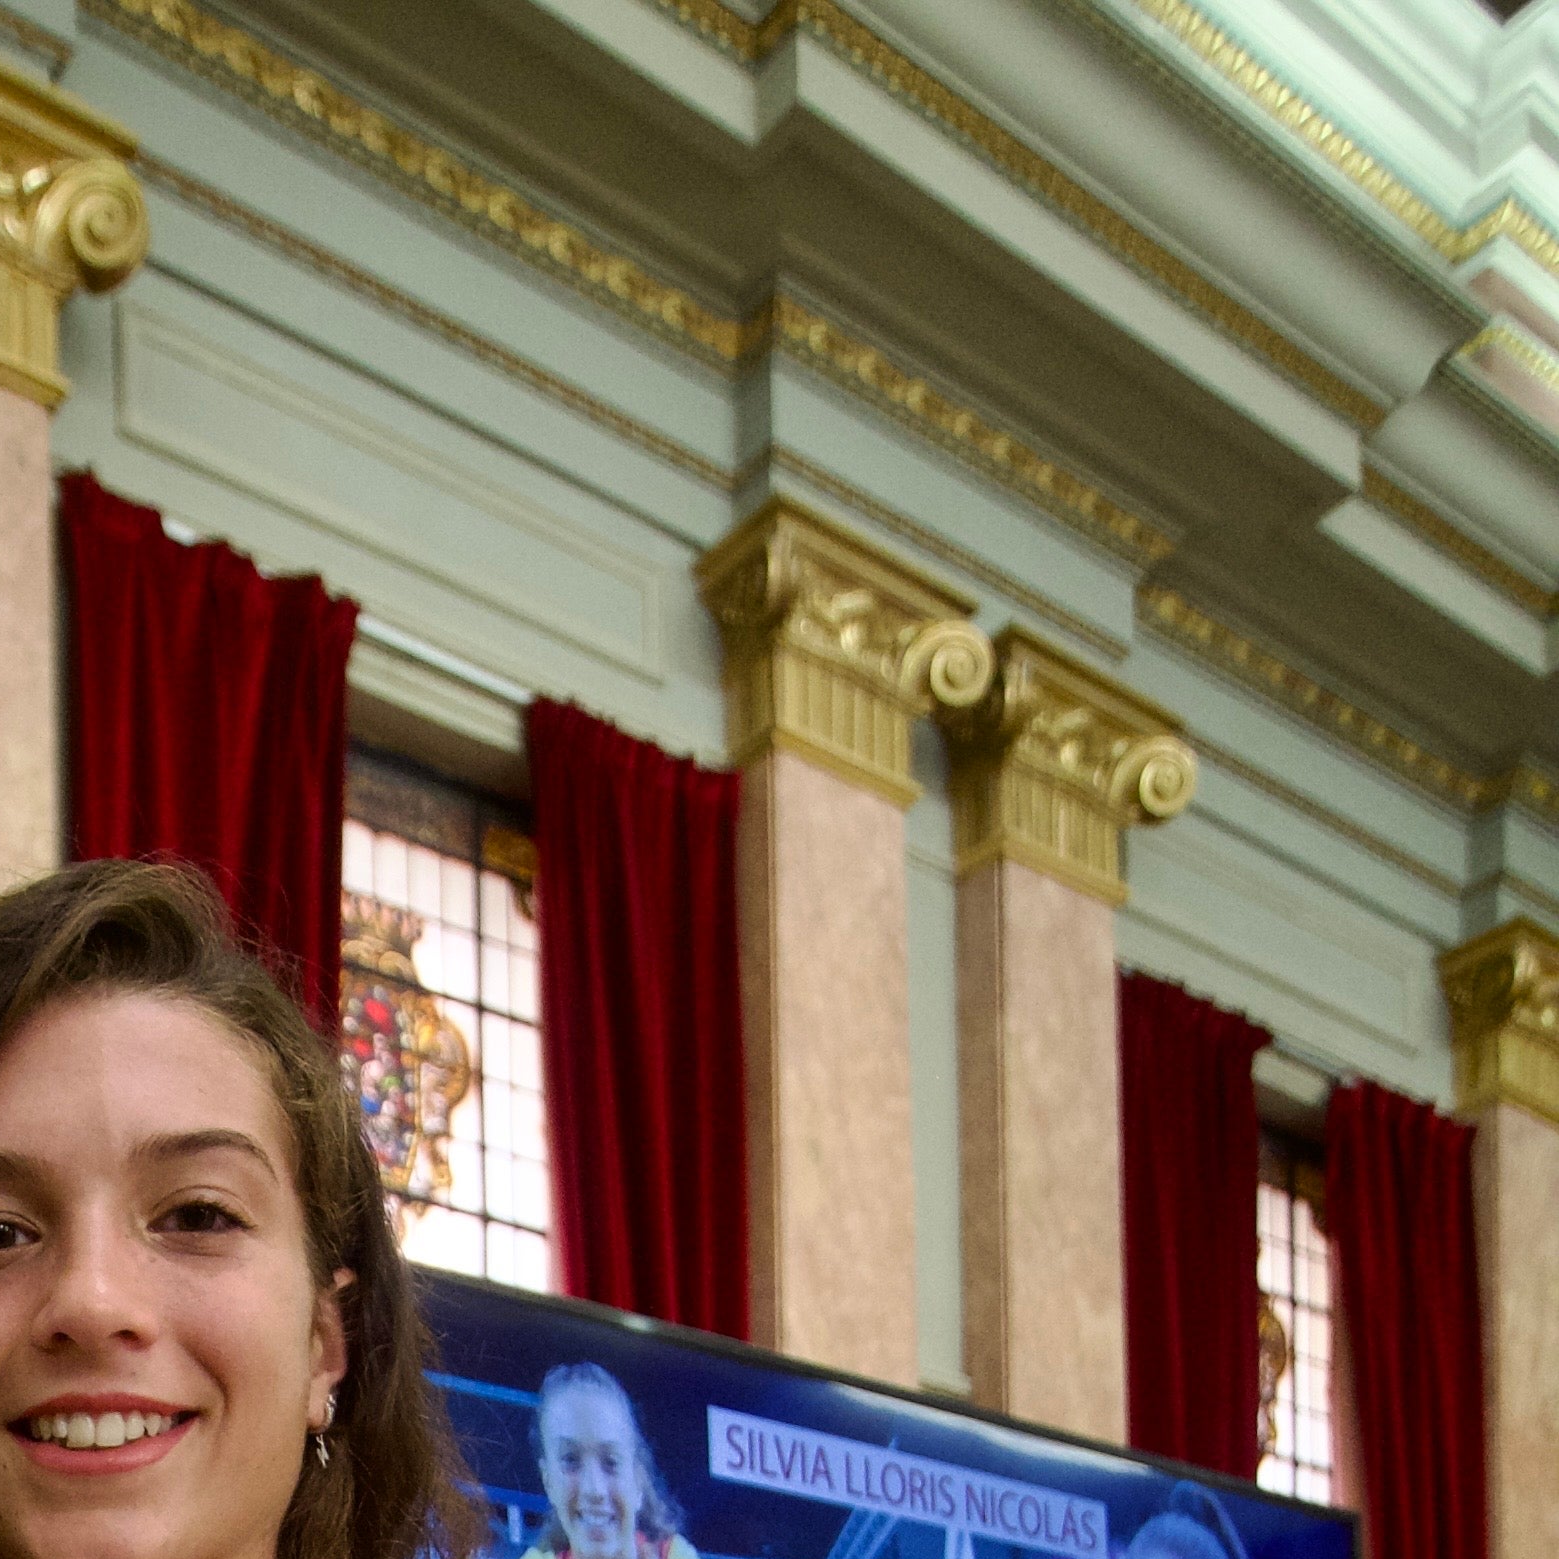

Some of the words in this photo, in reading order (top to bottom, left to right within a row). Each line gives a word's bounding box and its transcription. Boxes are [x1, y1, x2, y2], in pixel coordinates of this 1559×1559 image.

[726, 1424, 835, 1490] SILVIA
[845, 1451, 956, 1520] LLORIS
[966, 1484, 1099, 1552] NICOLÁS
